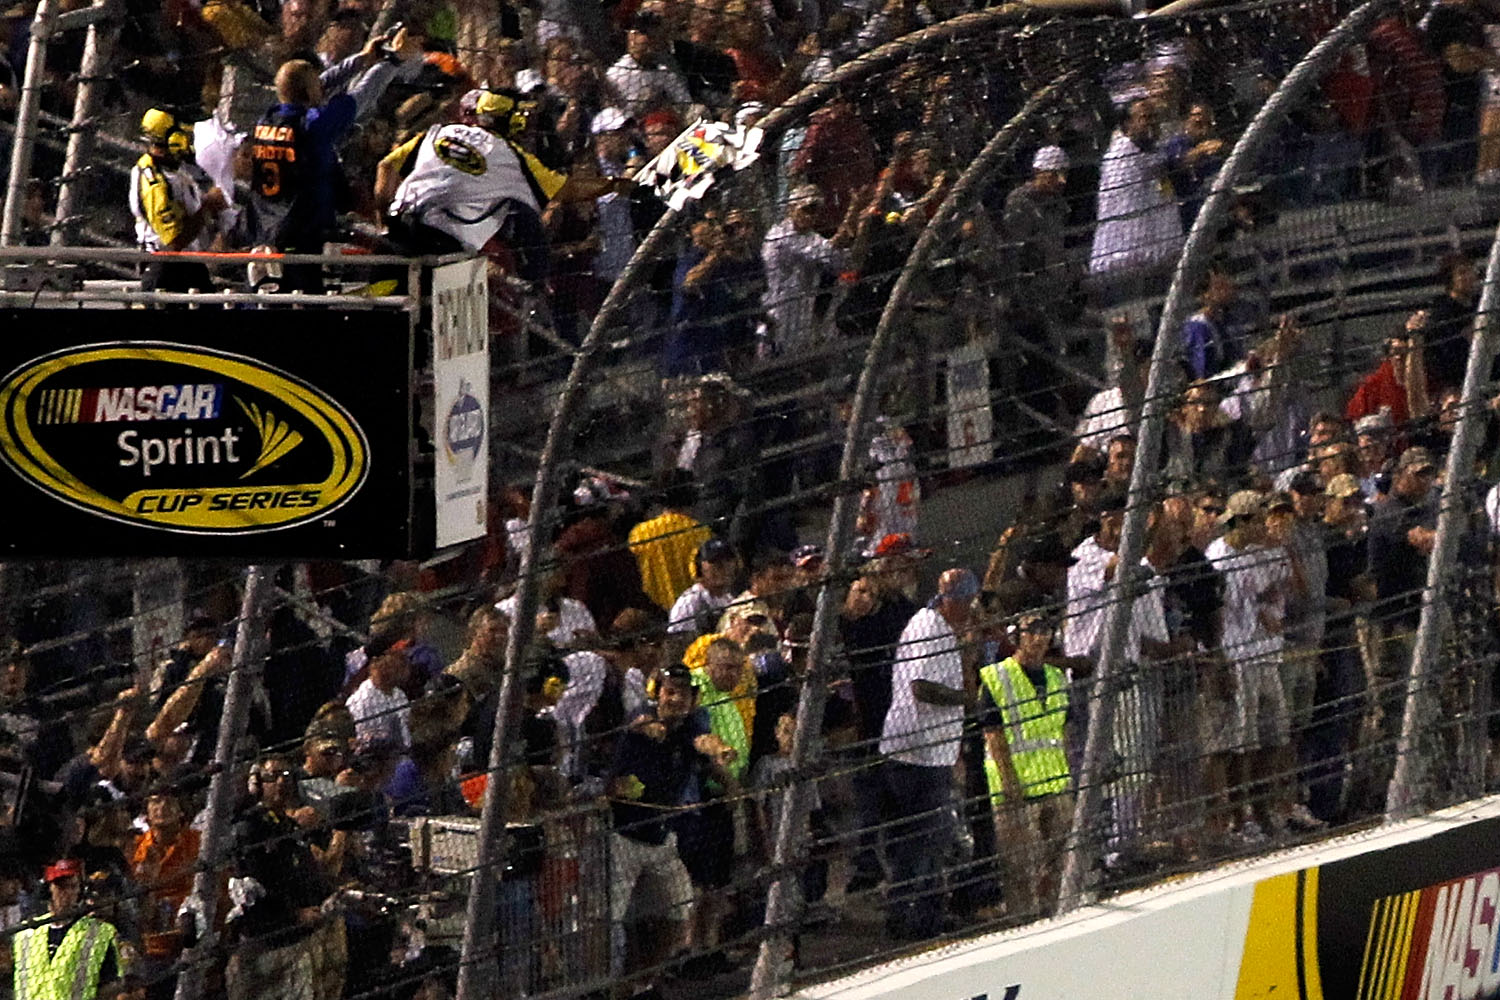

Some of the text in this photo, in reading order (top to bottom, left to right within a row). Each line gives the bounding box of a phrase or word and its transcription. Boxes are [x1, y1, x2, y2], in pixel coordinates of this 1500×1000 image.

[261, 162, 281, 196] 3
[94, 384, 216, 422] NASCAR
[118, 428, 241, 477] Sprint
[136, 490, 322, 514] CUP SERIES
